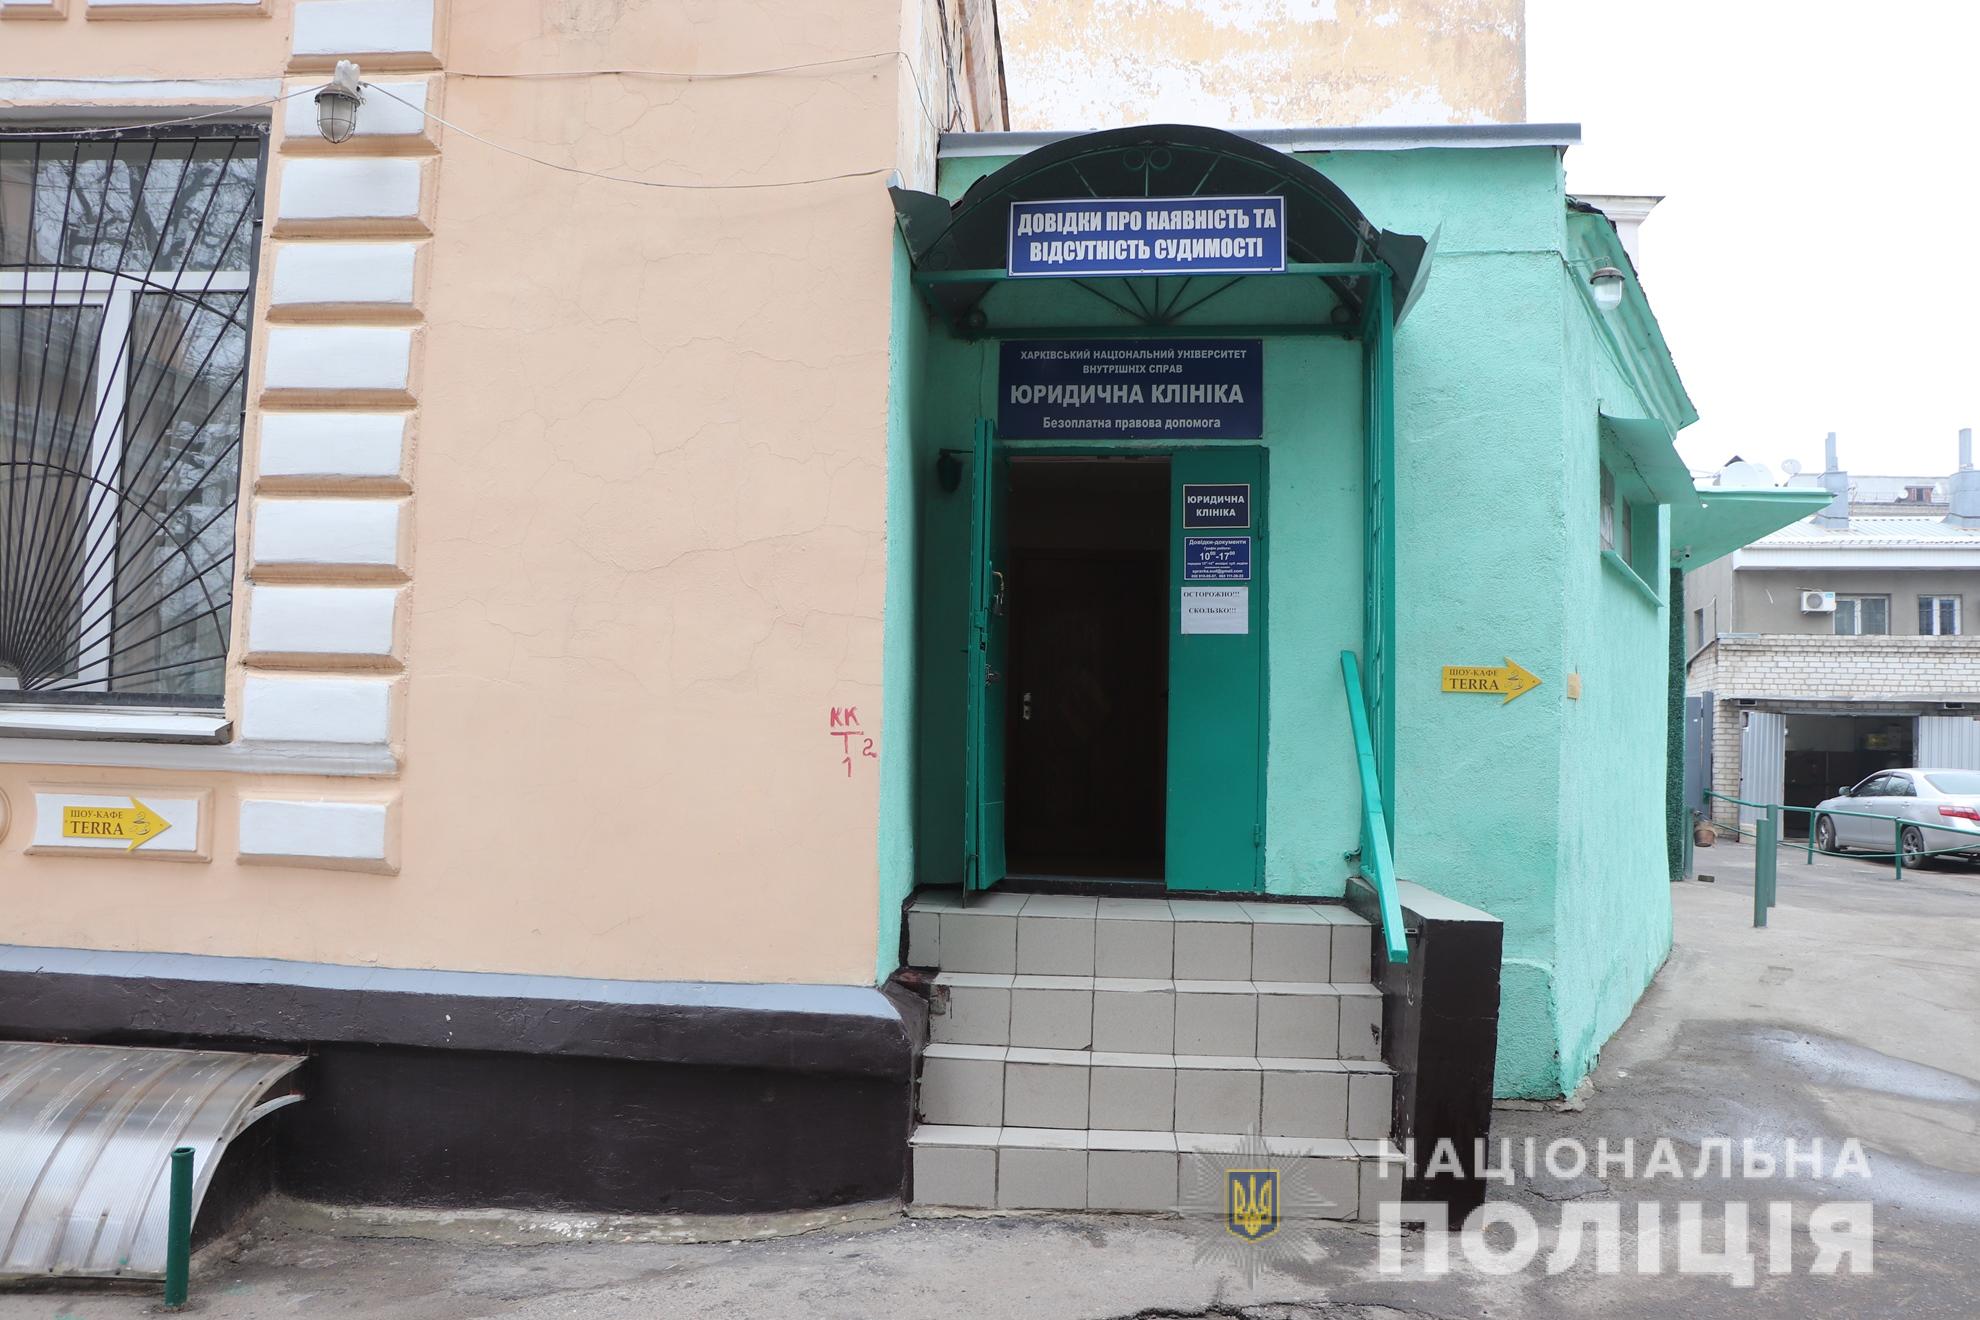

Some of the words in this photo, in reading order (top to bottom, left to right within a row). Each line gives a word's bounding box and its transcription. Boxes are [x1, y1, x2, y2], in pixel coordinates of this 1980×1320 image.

[1018, 212, 1101, 236] ДОВІДКИ
[1106, 211, 1142, 231] ПРО
[1146, 209, 1249, 230] НАЯВНІСТЬ
[1253, 208, 1276, 228] ТА
[1029, 239, 1150, 264] ВІДСУТНІСТЬ
[1154, 237, 1262, 261] СУДИМОСТІ
[1020, 349, 1091, 360] ХАРКІВСЬКИЙ
[1093, 349, 1175, 361] НАЦІОНАЛЬНИЙ
[1177, 349, 1247, 359] УНІВЕРСИТЕТ
[1083, 364, 1146, 374] ВНУТРІШНІХ
[1149, 364, 1183, 373] СПРАВ
[1010, 384, 1144, 407] ЮРИДИЧНА
[1151, 384, 1244, 403] КЛІНІКА
[1043, 416, 1111, 428] Безоплатна
[1115, 418, 1161, 431] правова
[1164, 418, 1221, 430] допомога
[1187, 495, 1245, 505] ЮРИДИЧНА
[1196, 508, 1236, 517] КЛІНІКА
[1449, 668, 1497, 677] ШОУ-КАФЕ
[1449, 678, 1499, 691] TERRA
[70, 809, 123, 820] ШОУ-КАФЕ
[70, 820, 124, 835] TERRA
